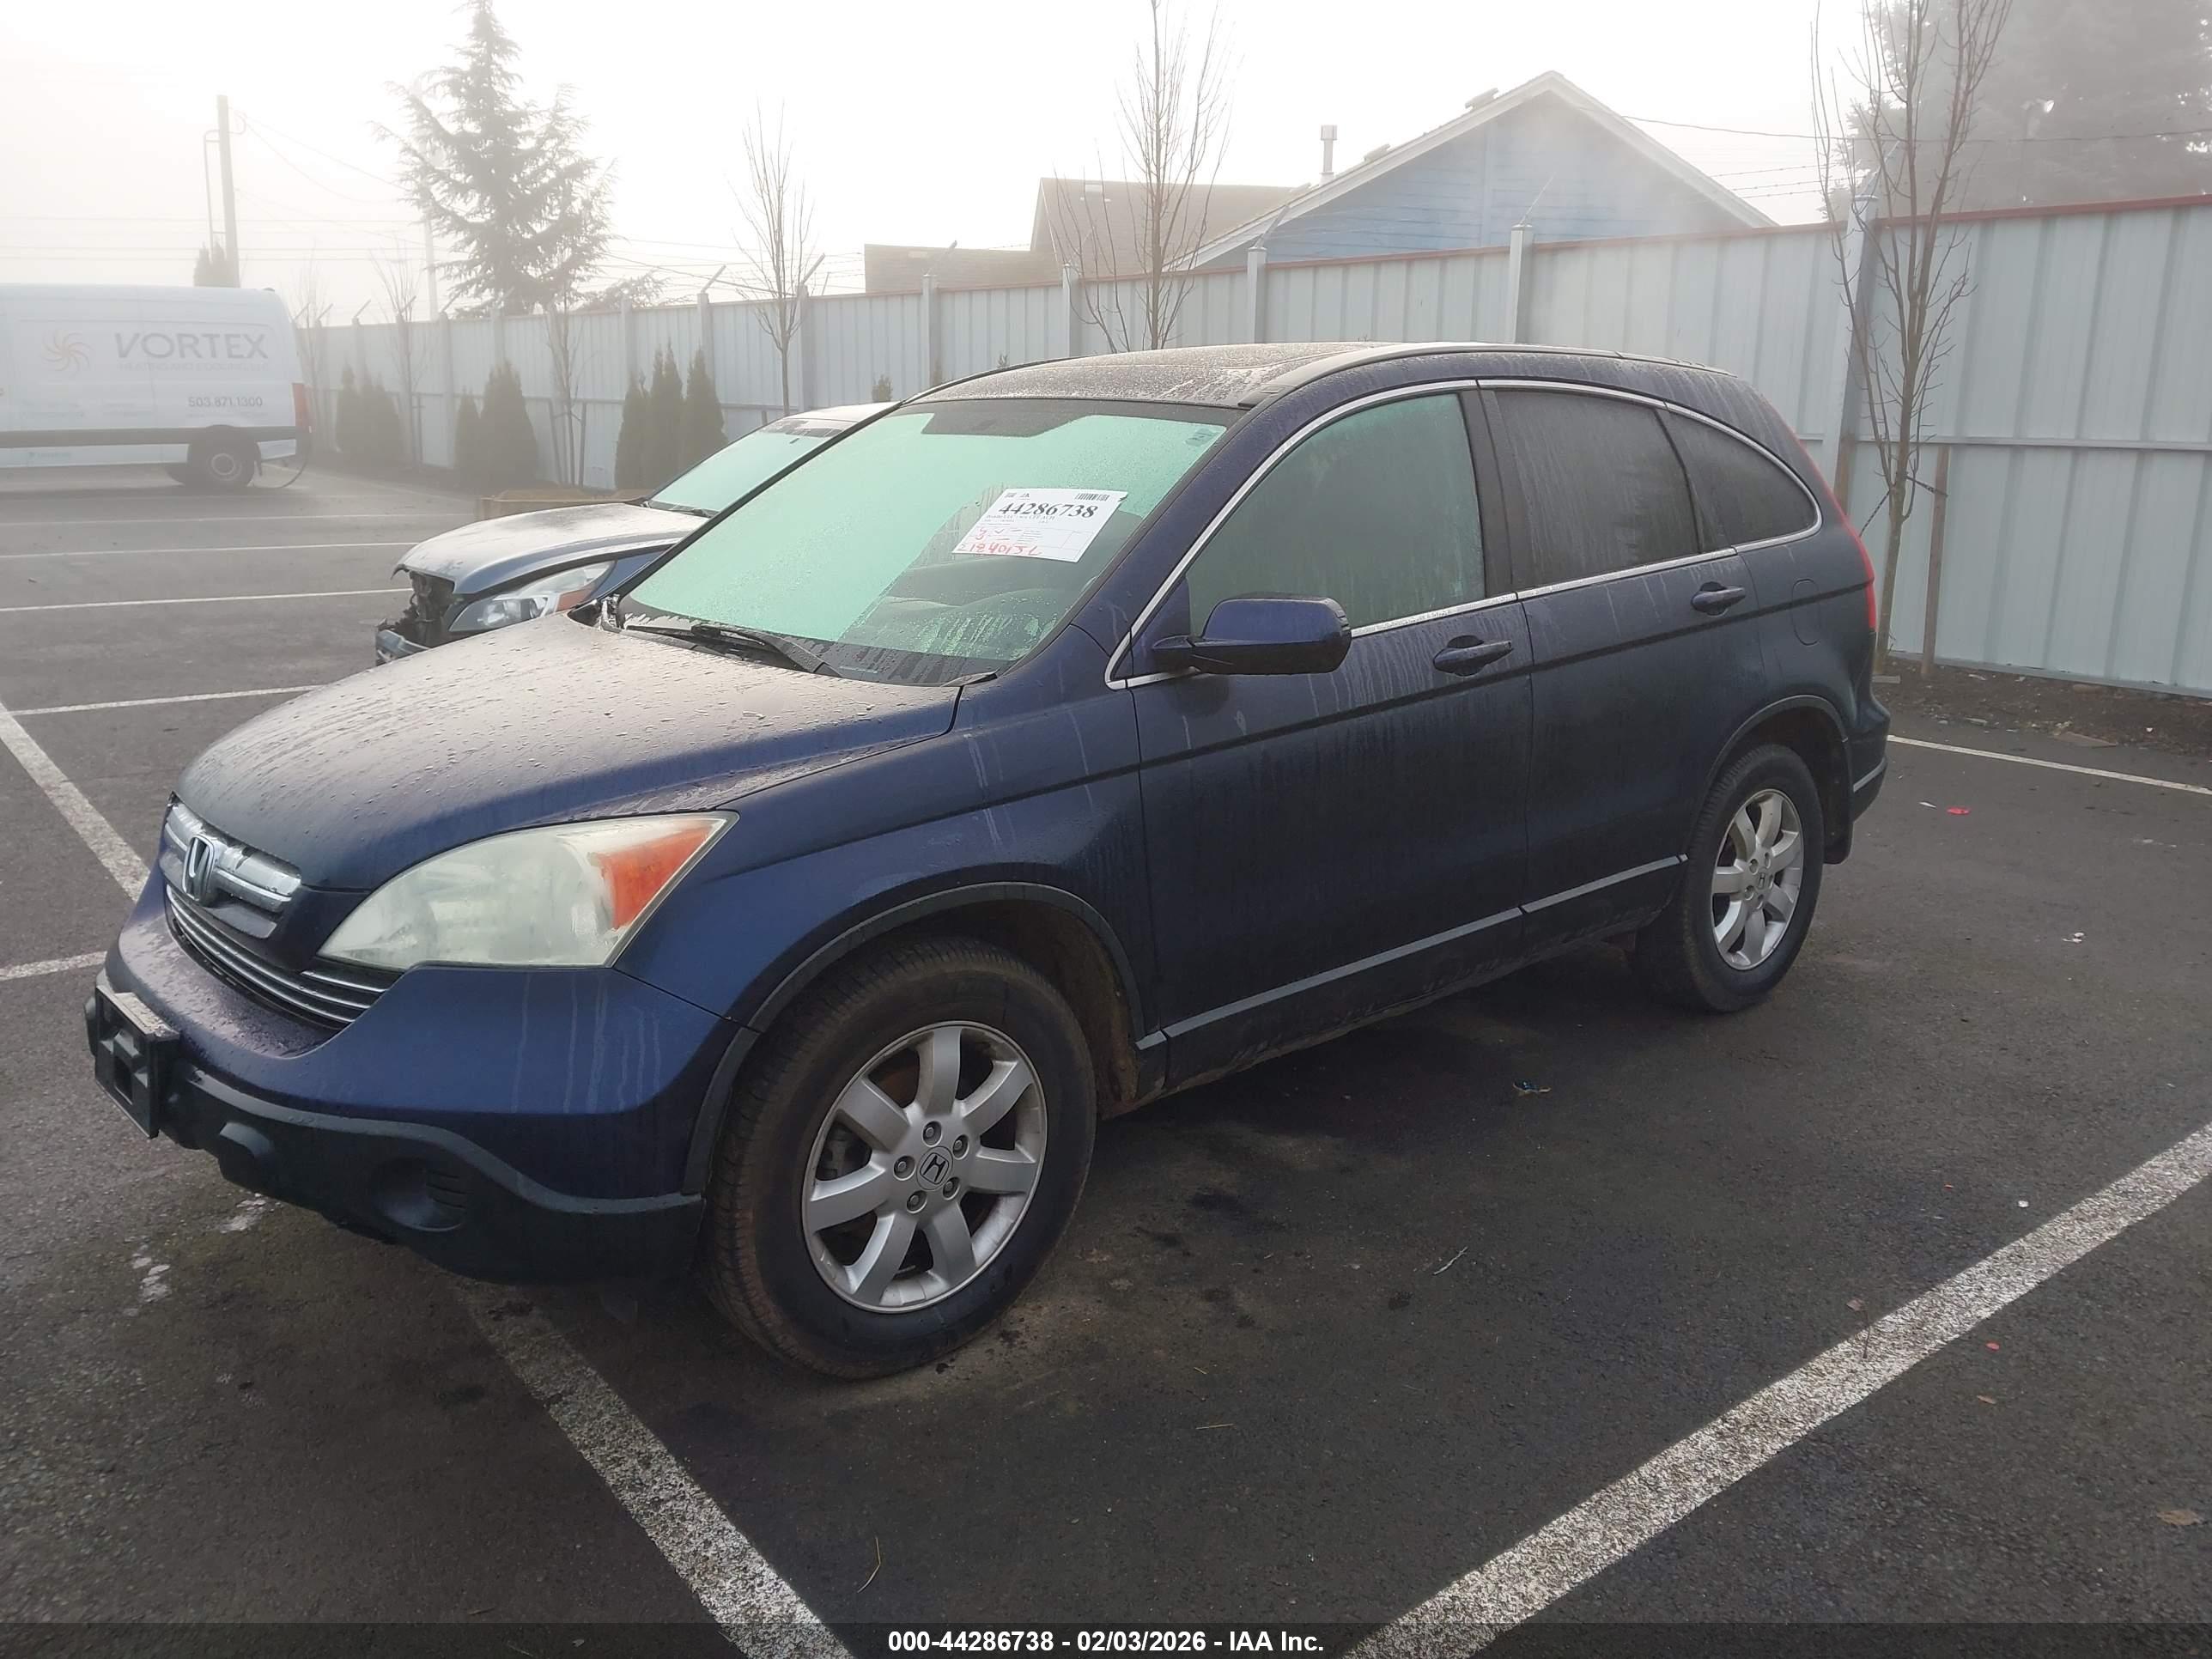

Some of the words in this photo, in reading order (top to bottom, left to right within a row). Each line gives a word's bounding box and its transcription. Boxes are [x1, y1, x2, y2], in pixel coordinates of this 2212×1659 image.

[114, 332, 269, 359] VORTEX
[188, 395, 264, 409] 503.871.1300
[999, 502, 1099, 519] 44286738
